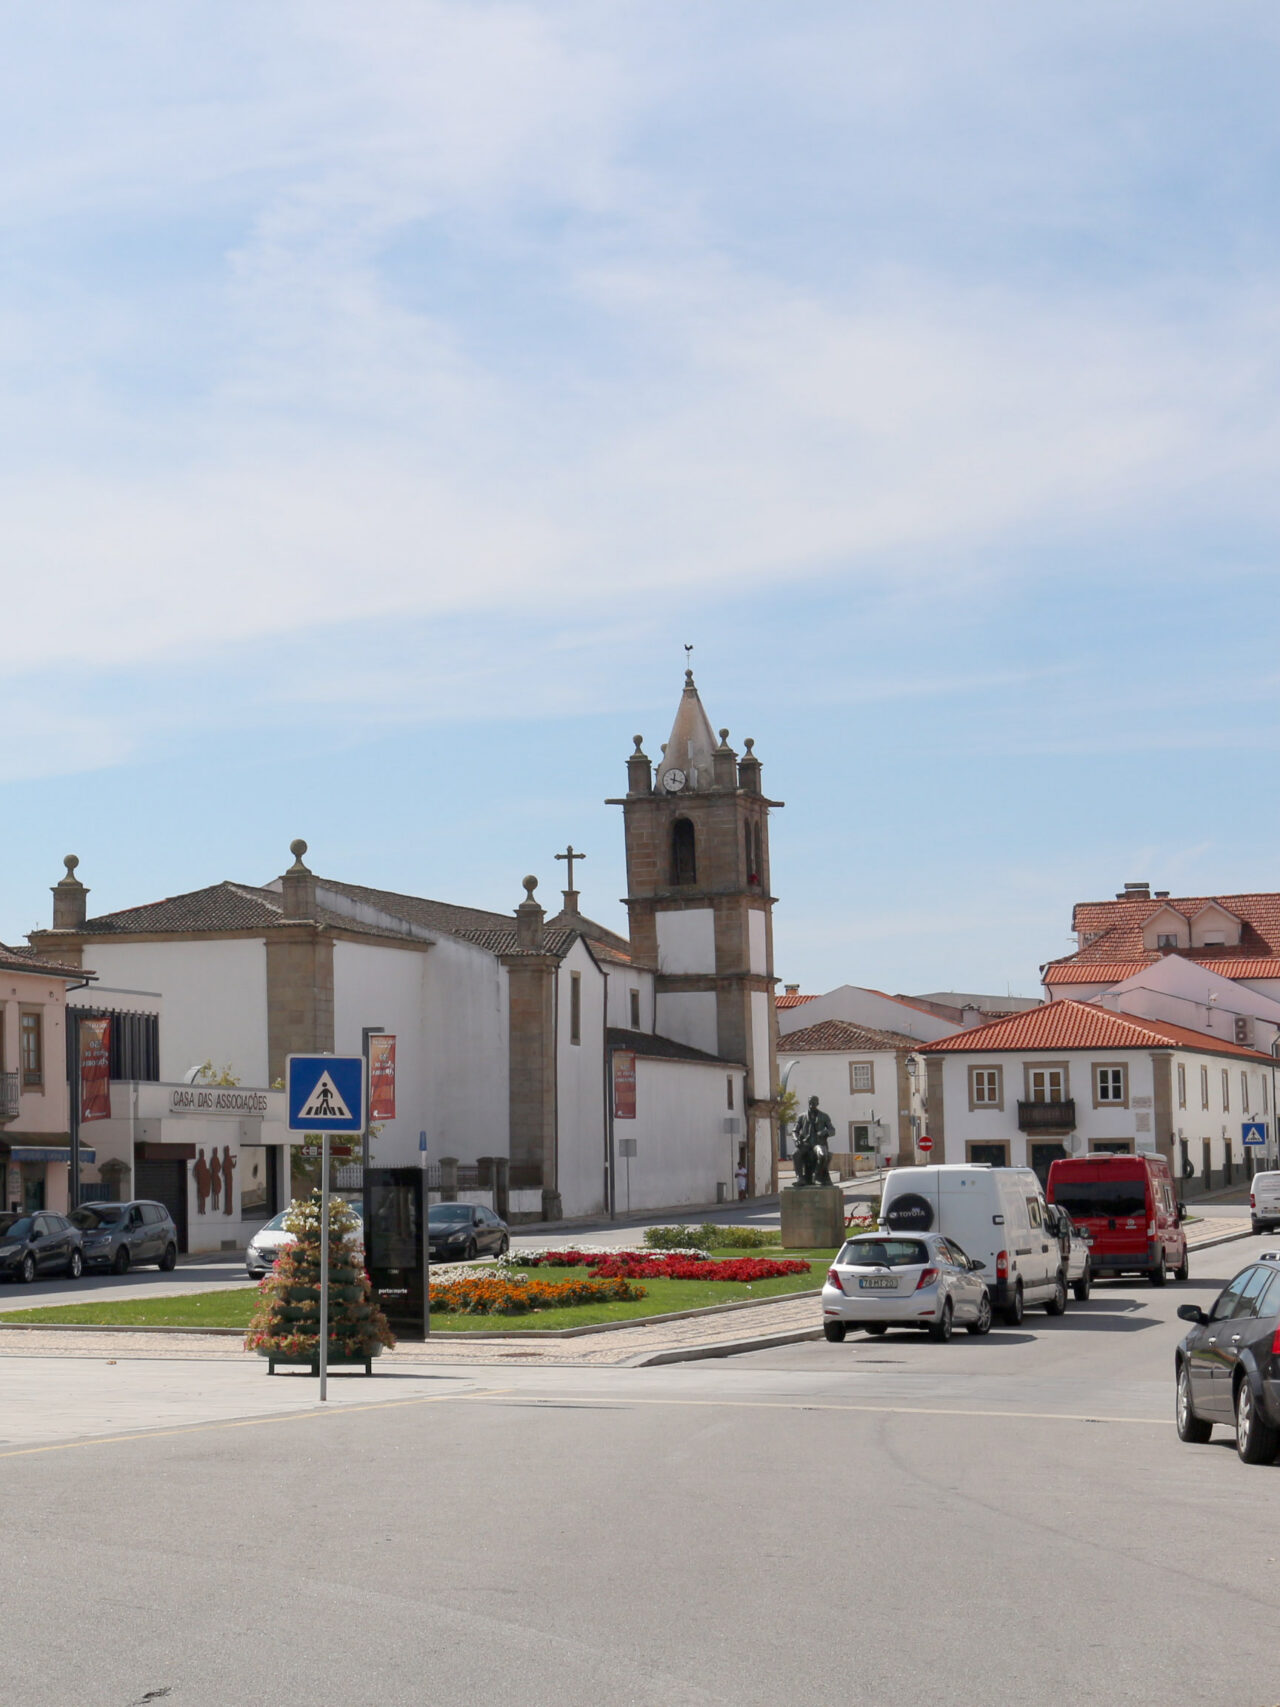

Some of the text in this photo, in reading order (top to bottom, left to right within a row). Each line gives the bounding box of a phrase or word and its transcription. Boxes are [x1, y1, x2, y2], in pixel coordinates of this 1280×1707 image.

[173, 1090, 268, 1113] CASA DAS ASSOCIAÇÕES
